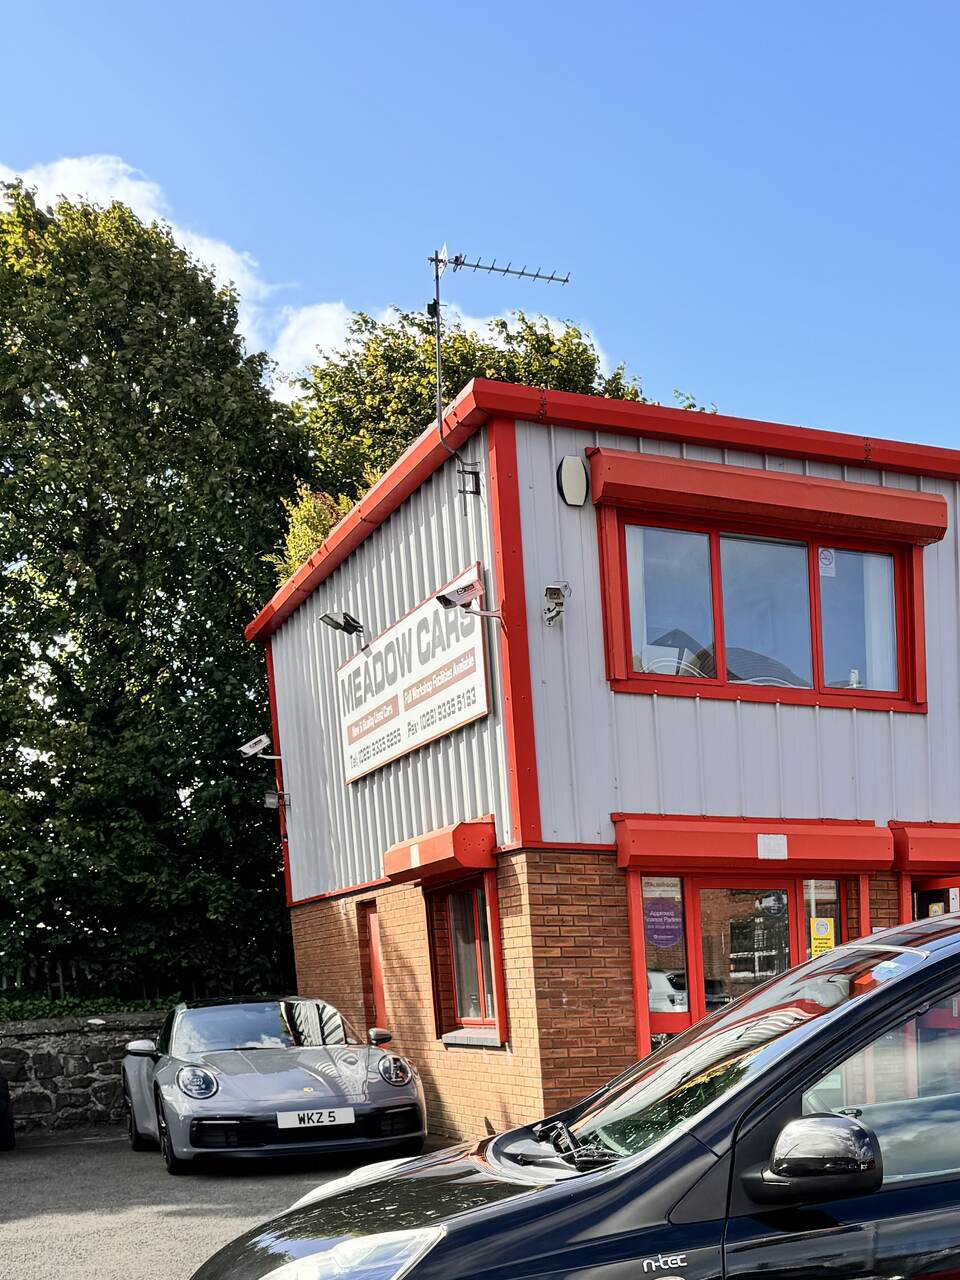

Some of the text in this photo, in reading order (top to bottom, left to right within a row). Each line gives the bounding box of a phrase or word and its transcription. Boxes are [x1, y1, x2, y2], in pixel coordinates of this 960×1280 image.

[341, 604, 475, 717] MEADOW CARS
[297, 1110, 337, 1125] WKZ 5
[642, 1253, 688, 1273] n-tec
